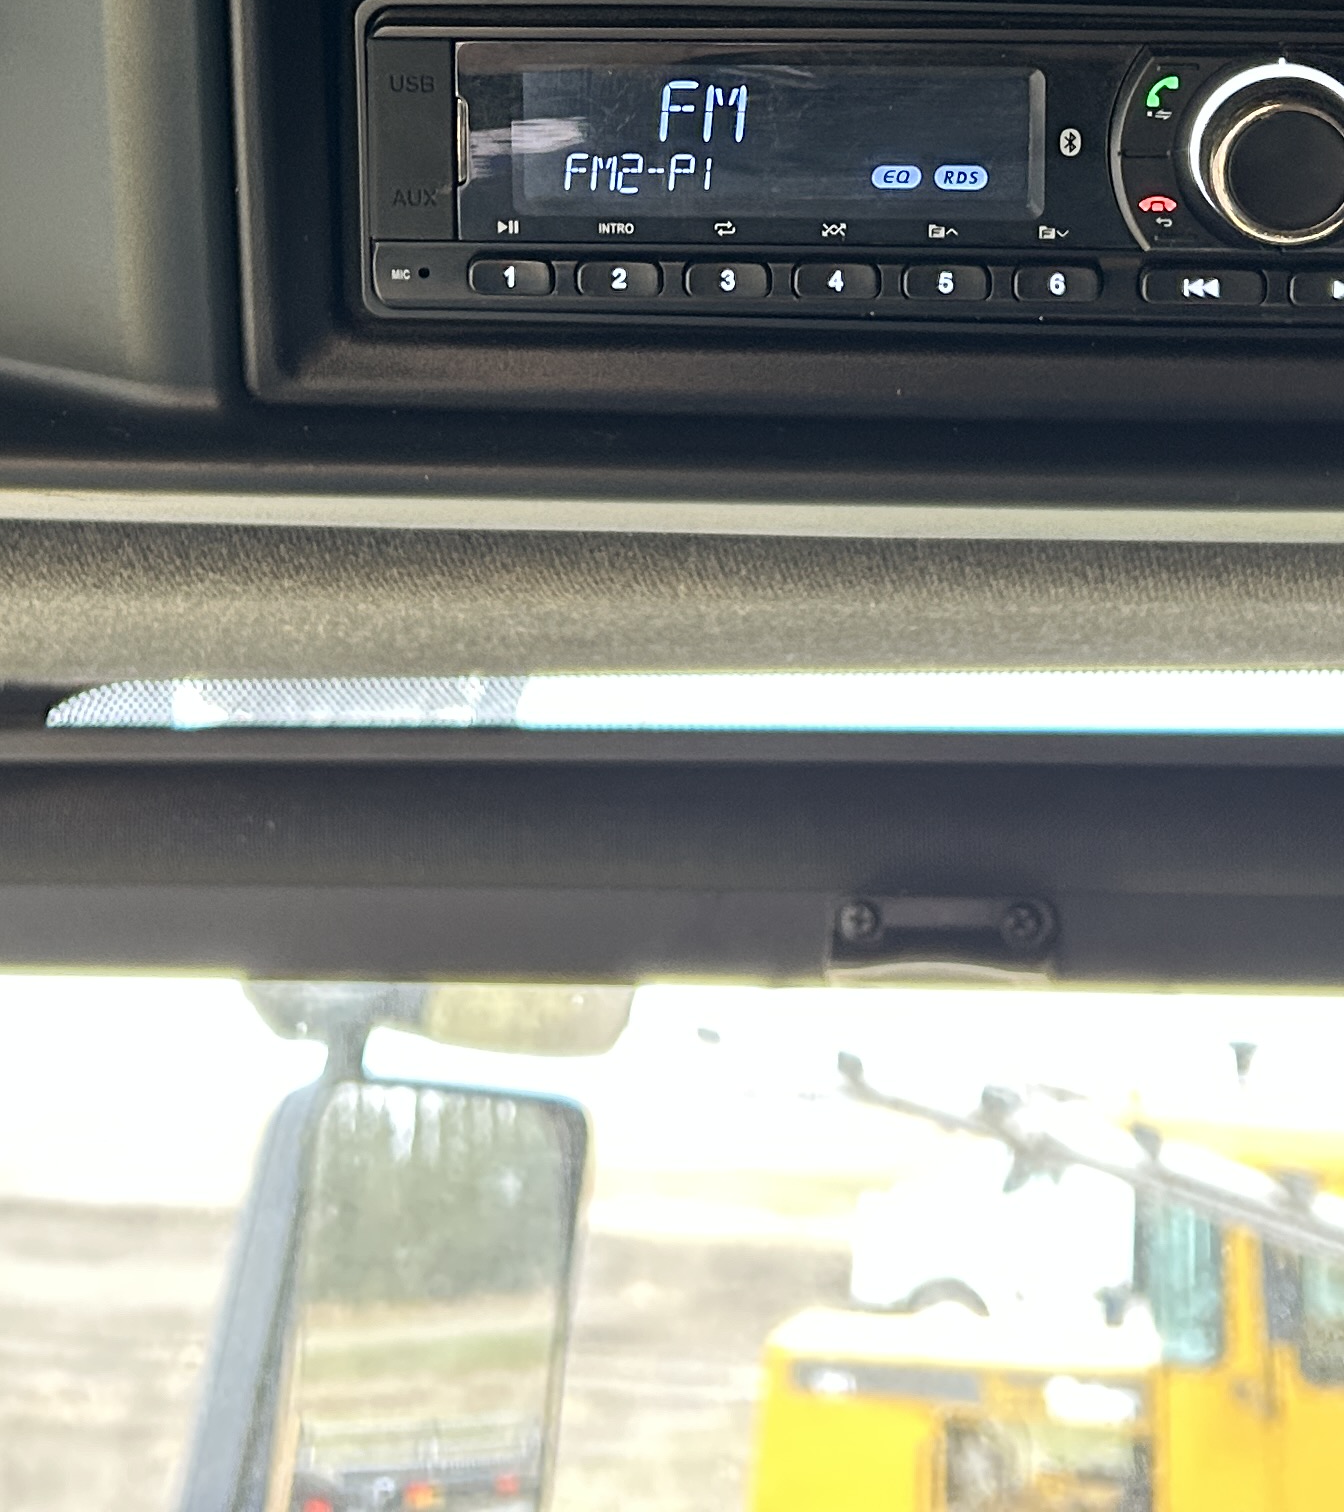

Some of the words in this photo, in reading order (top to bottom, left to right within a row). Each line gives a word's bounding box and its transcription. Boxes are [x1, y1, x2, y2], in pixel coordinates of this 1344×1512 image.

[389, 74, 435, 93] USB
[659, 80, 748, 143] FM
[883, 169, 910, 184] EQ
[943, 170, 979, 185] RDS
[392, 189, 438, 207] AUX
[598, 222, 635, 235] INTRO
[391, 269, 411, 280] MIC
[503, 266, 516, 288] 1
[611, 267, 628, 290] 2
[720, 269, 736, 292] 3
[827, 269, 844, 292] 4
[937, 270, 954, 294] 5
[1049, 272, 1066, 296] 6
